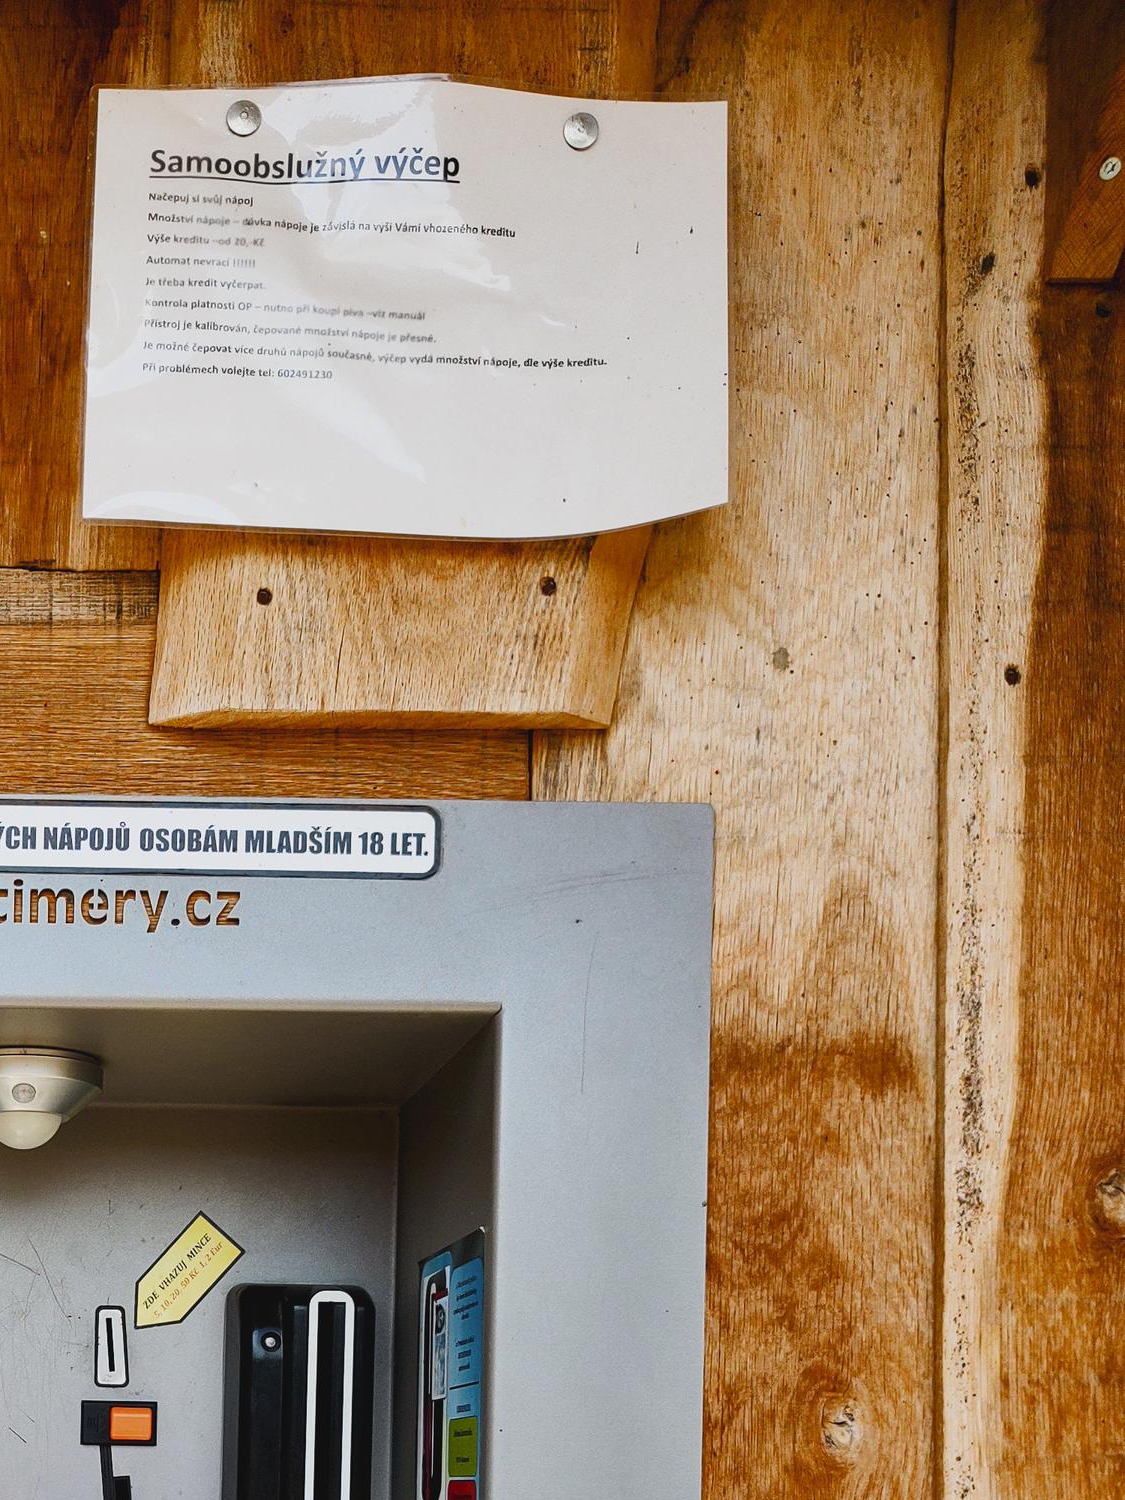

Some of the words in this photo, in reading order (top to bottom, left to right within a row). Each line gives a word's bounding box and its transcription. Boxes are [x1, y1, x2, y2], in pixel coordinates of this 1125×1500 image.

[150, 149, 365, 180] Samoobslužný
[375, 147, 460, 181] výčep
[148, 193, 189, 203] Načepuj
[192, 195, 200, 203] si
[203, 195, 223, 204] svůj
[225, 196, 254, 207] nápoj
[148, 213, 194, 223] Množství
[196, 216, 230, 225] nápoje
[275, 220, 308, 231] nápoje
[310, 222, 319, 233] je
[358, 223, 370, 231] na
[481, 225, 516, 238] kreditu
[174, 235, 209, 244] kreditu
[146, 256, 190, 265] Automat
[146, 278, 156, 286] Je
[158, 279, 185, 287] třeba
[191, 300, 235, 310] platnosti
[238, 302, 252, 310] OP
[183, 322, 192, 330] je
[352, 330, 385, 341] nápoje
[388, 333, 397, 341] je
[143, 341, 153, 349] Je
[192, 343, 232, 354] čepovat
[436, 358, 481, 366] množství
[483, 357, 521, 368] nápoje,
[524, 358, 539, 367] dle
[542, 358, 564, 369] výše
[159, 364, 218, 374] problémech
[221, 366, 256, 377] volejte
[258, 369, 275, 377] tel:
[278, 369, 332, 379] 602491230
[43, 822, 130, 851] NÁPOJŮ
[139, 824, 237, 853] OSOBÁM
[245, 826, 352, 855] MLADŠÍM
[358, 832, 384, 855] 18
[390, 832, 429, 857] LET.
[143, 1291, 159, 1309] ZDE
[159, 1260, 187, 1290] VHAZUJ
[186, 1233, 211, 1260] MINCE
